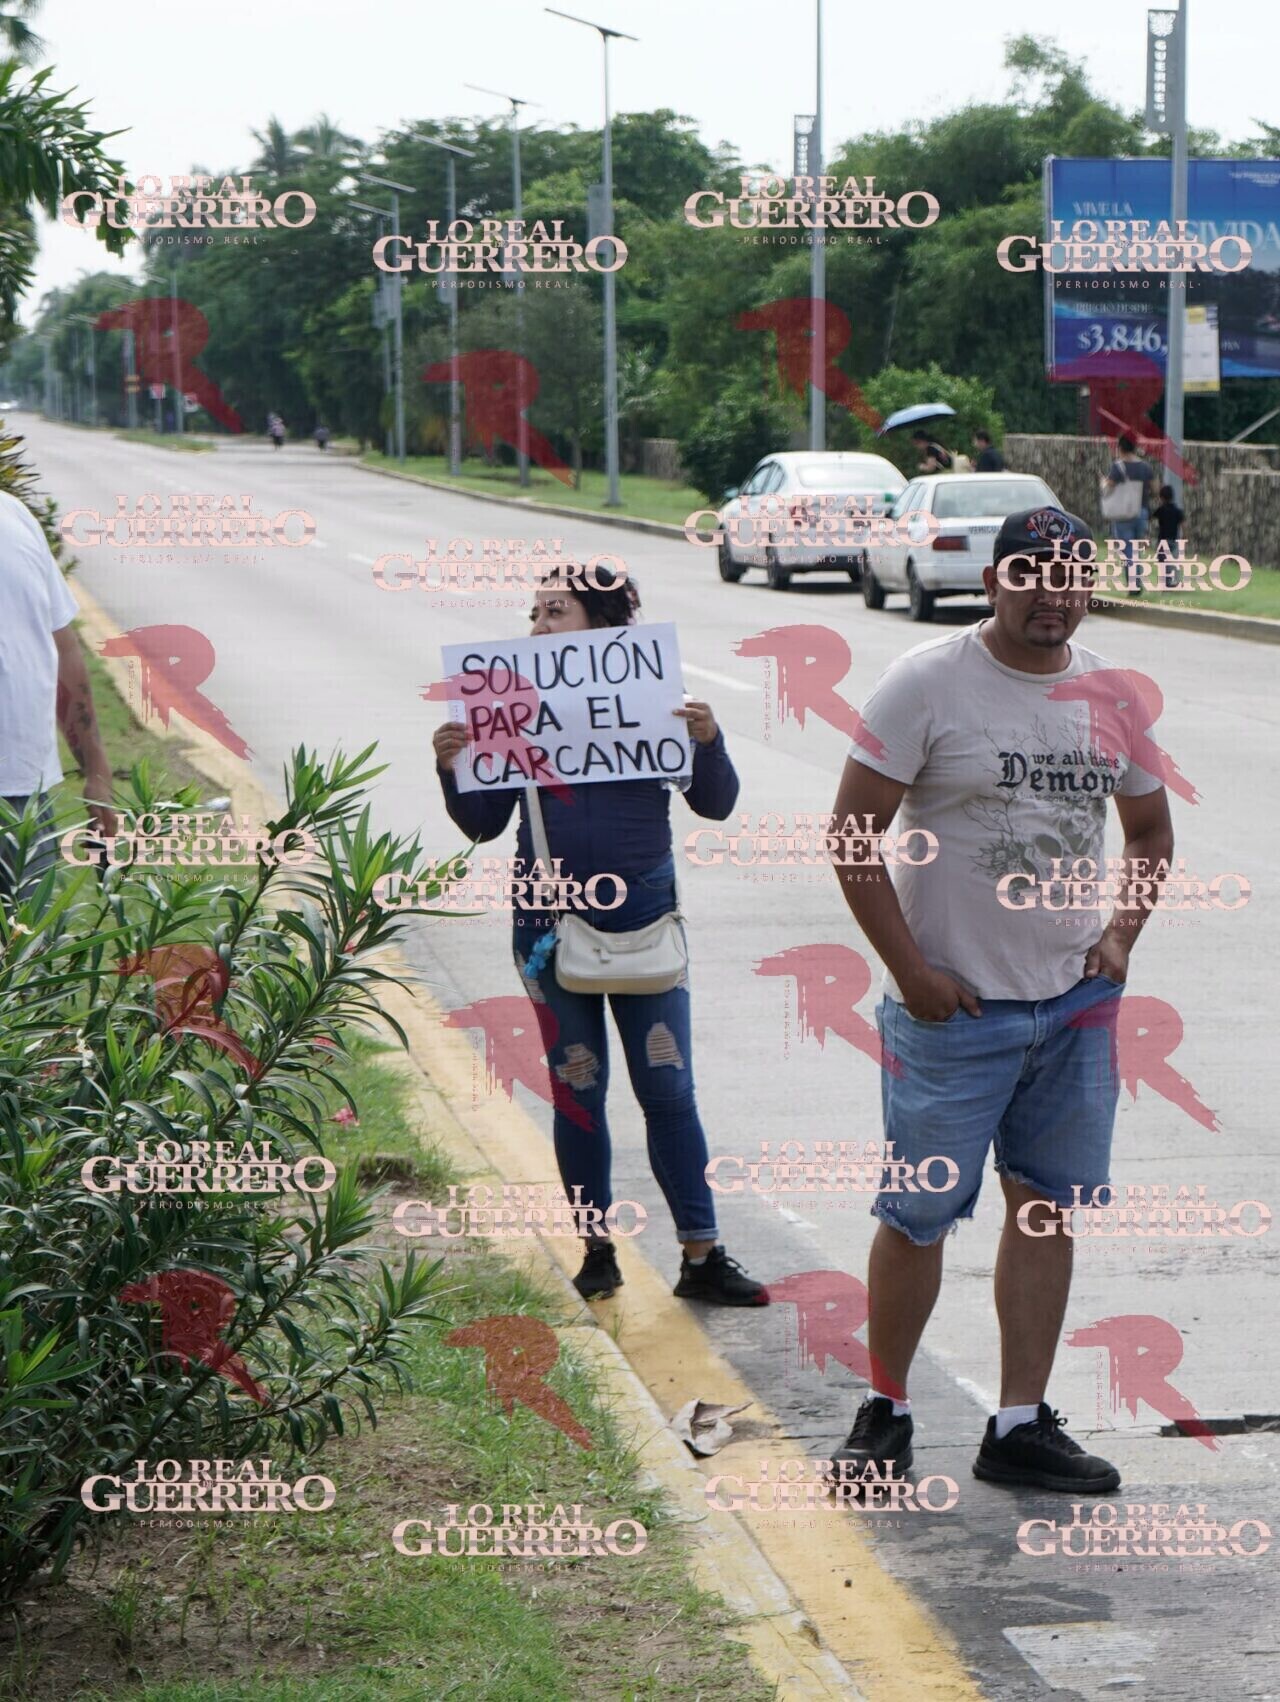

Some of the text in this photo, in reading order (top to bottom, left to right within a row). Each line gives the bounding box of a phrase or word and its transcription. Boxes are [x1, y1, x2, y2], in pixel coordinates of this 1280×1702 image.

[1077, 322, 1169, 357] $3,846,
[461, 630, 664, 696] SOLUCIÓN
[470, 694, 641, 743] PARA EL
[473, 738, 686, 786] CARCAMO
[1031, 753, 1054, 766] we
[1062, 750, 1086, 766] all
